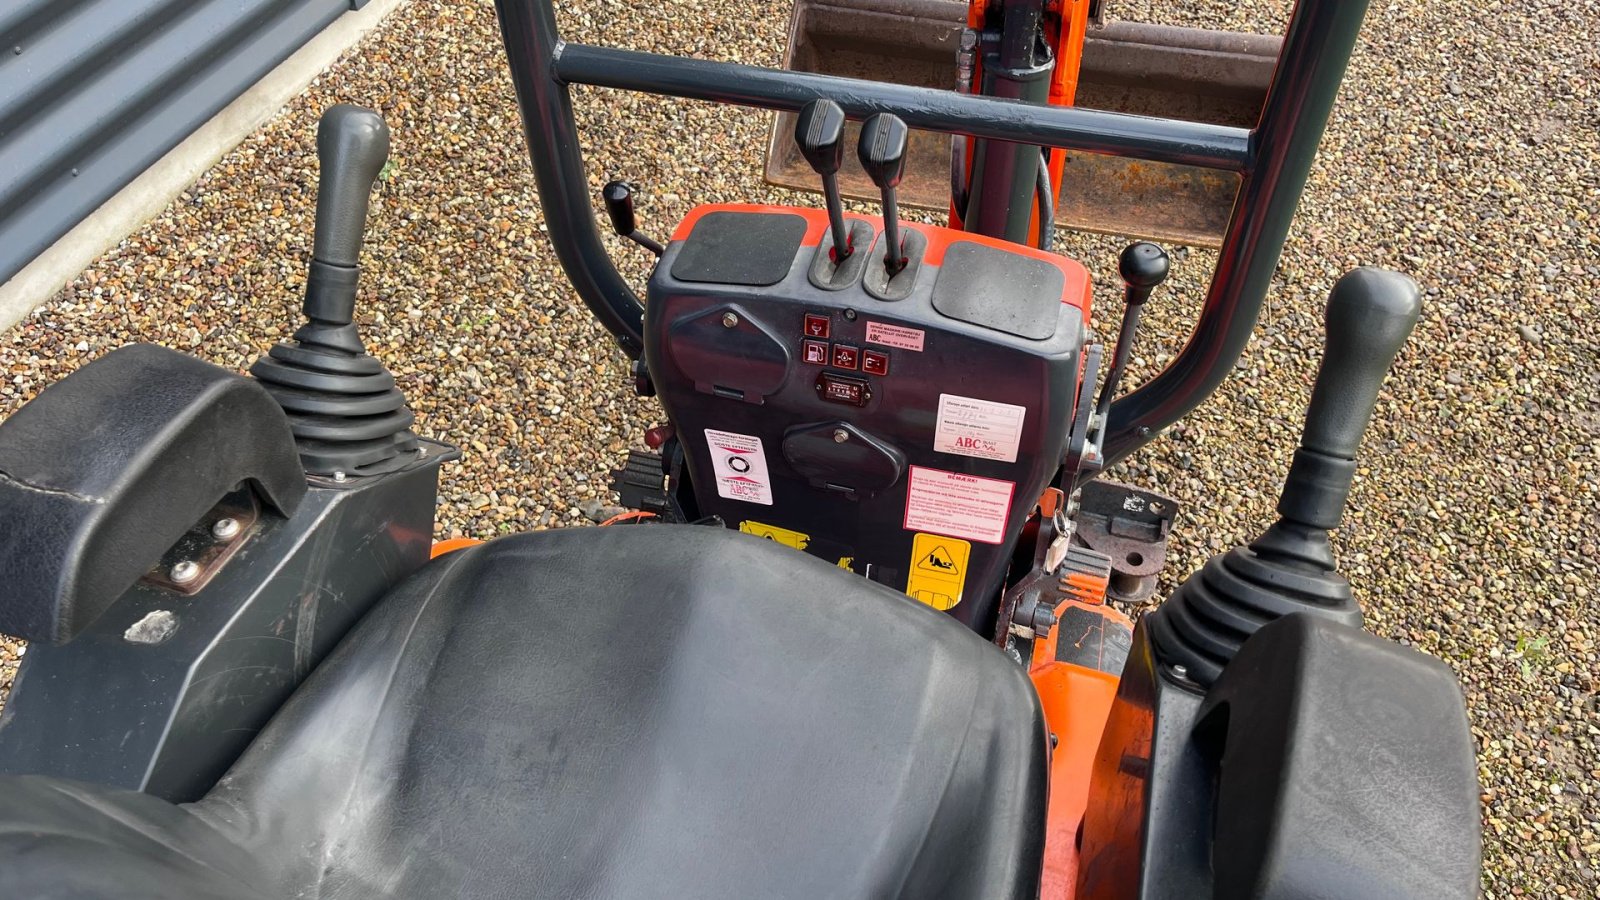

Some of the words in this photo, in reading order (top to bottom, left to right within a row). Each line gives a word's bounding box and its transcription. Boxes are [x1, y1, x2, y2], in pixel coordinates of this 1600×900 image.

[869, 333, 881, 342] ABC
[955, 436, 981, 450] ABC
[947, 474, 978, 483] BEMÆRK!
[730, 484, 748, 496] ABC
